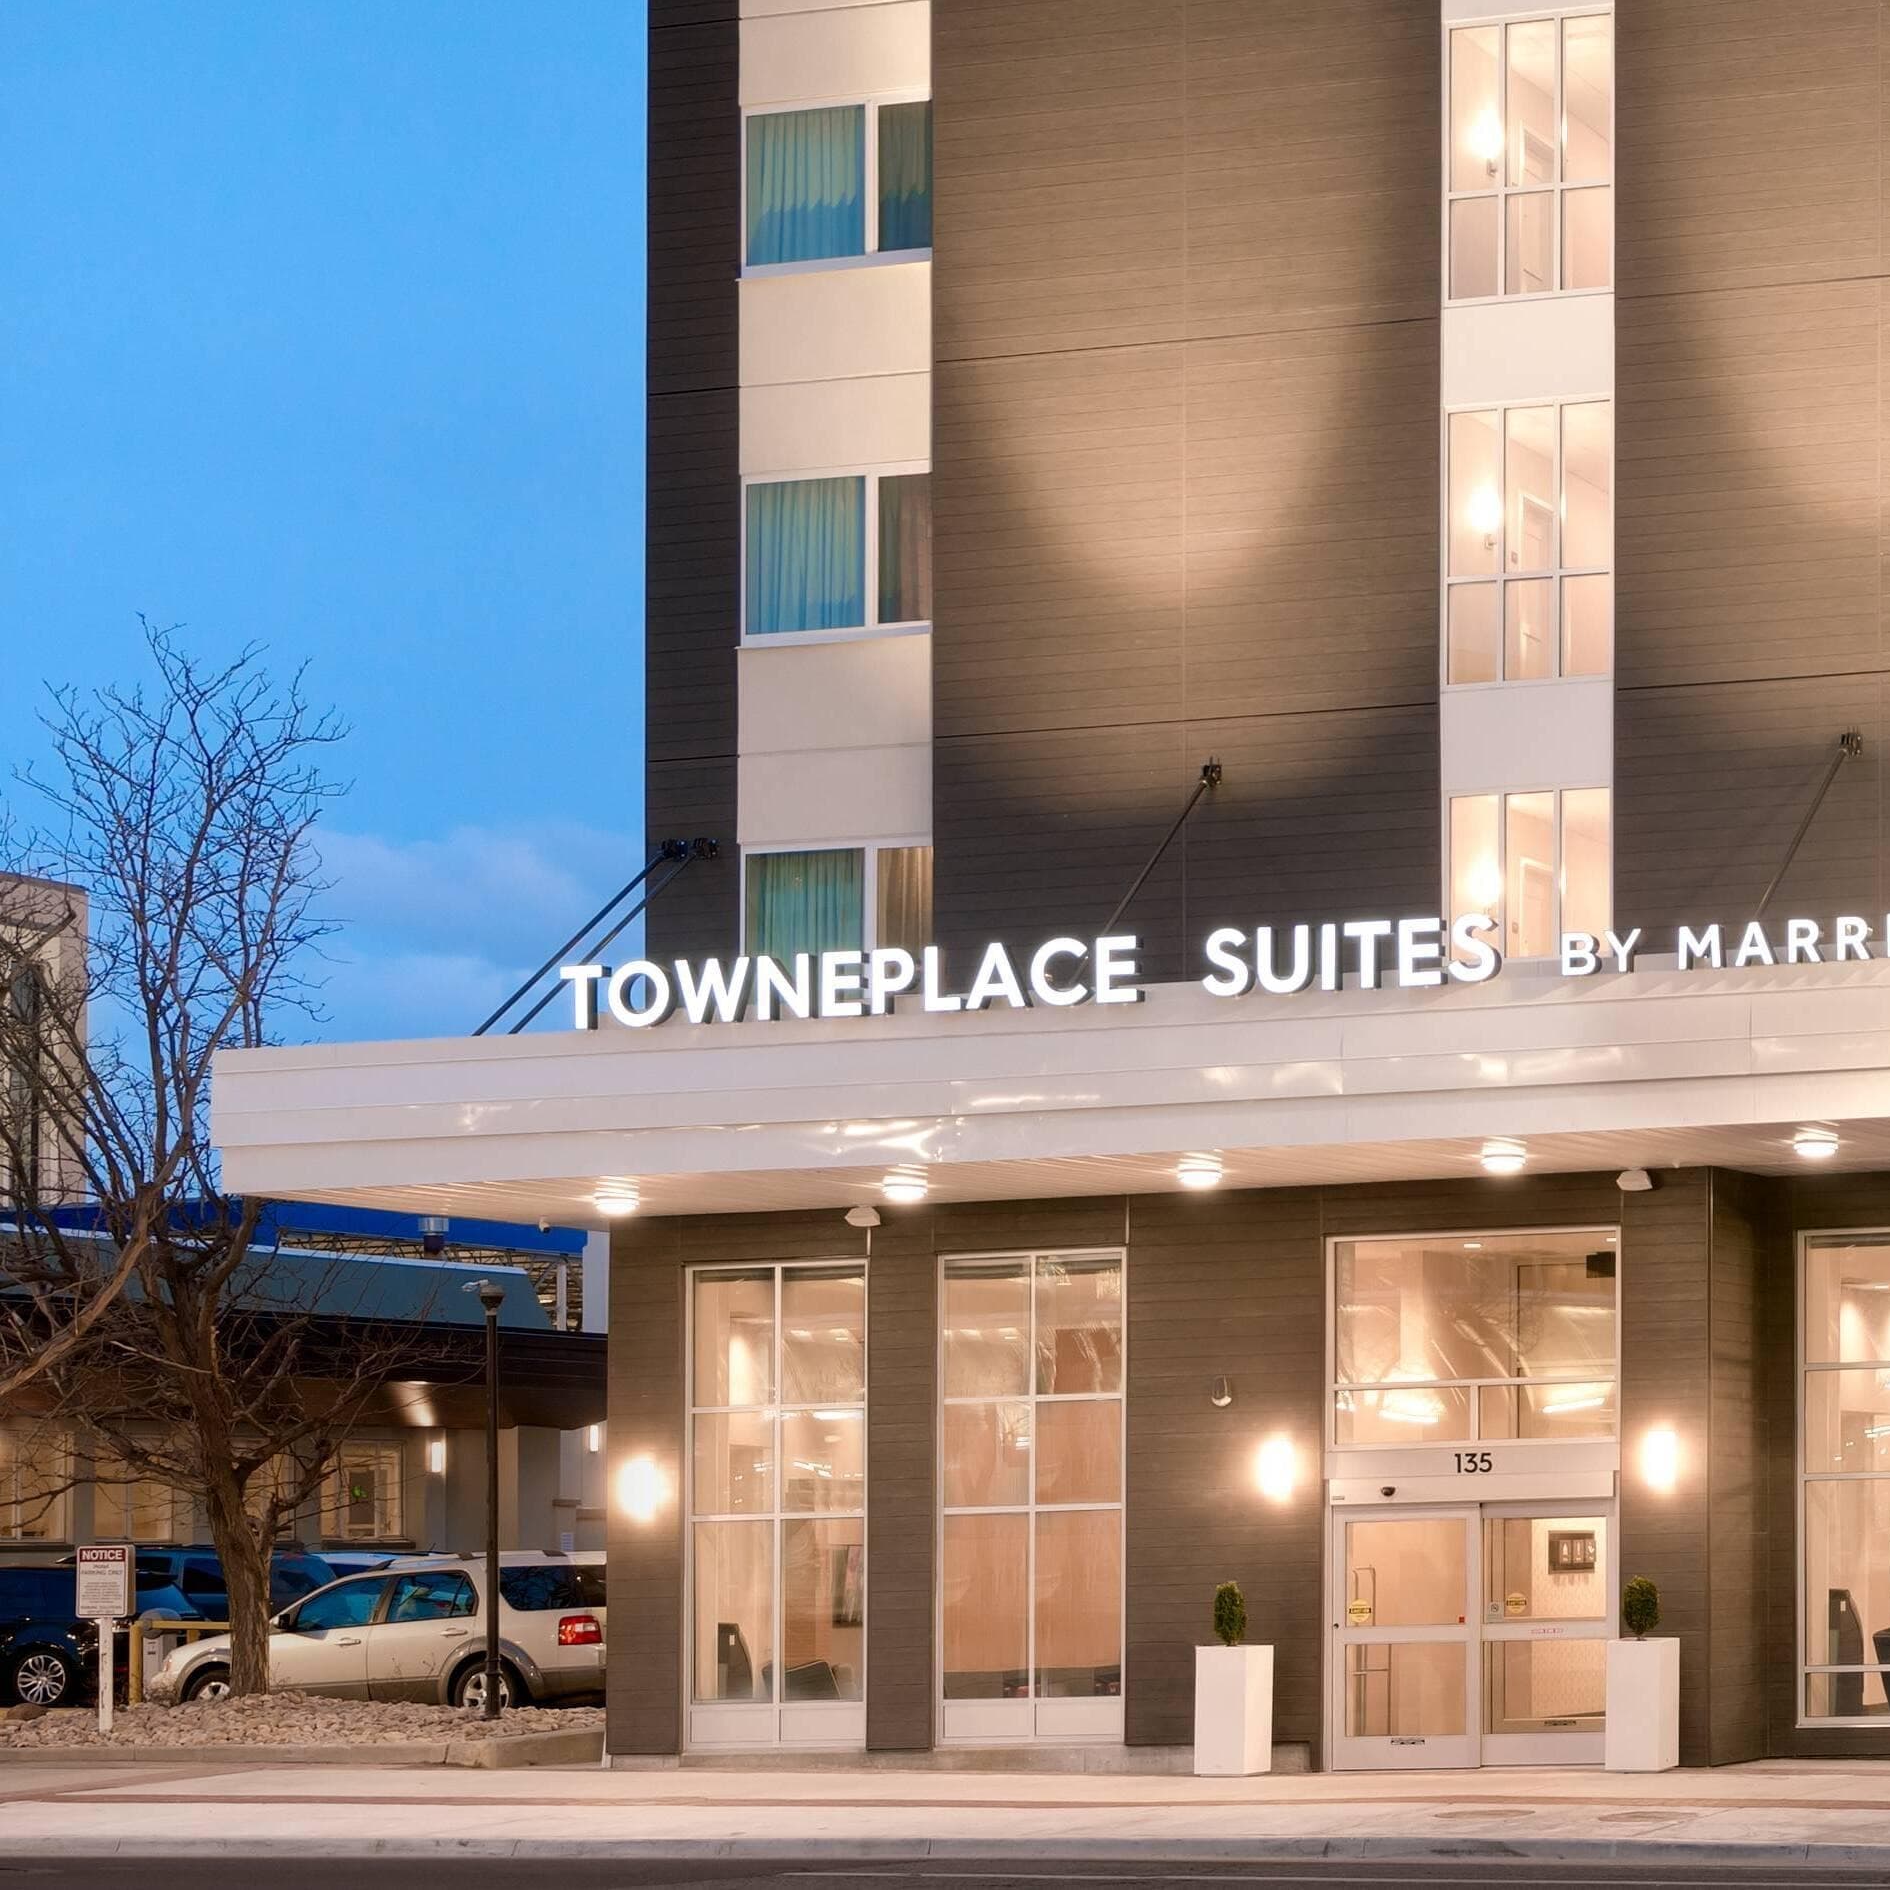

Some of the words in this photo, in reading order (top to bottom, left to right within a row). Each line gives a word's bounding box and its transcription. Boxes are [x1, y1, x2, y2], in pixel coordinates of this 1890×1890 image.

[559, 935, 1144, 1030] TOWNEPLACE
[1201, 912, 1502, 998] SUITES
[1561, 928, 1643, 977] BY
[1454, 1452, 1493, 1473] 135
[81, 1549, 124, 1560] NOTICE
